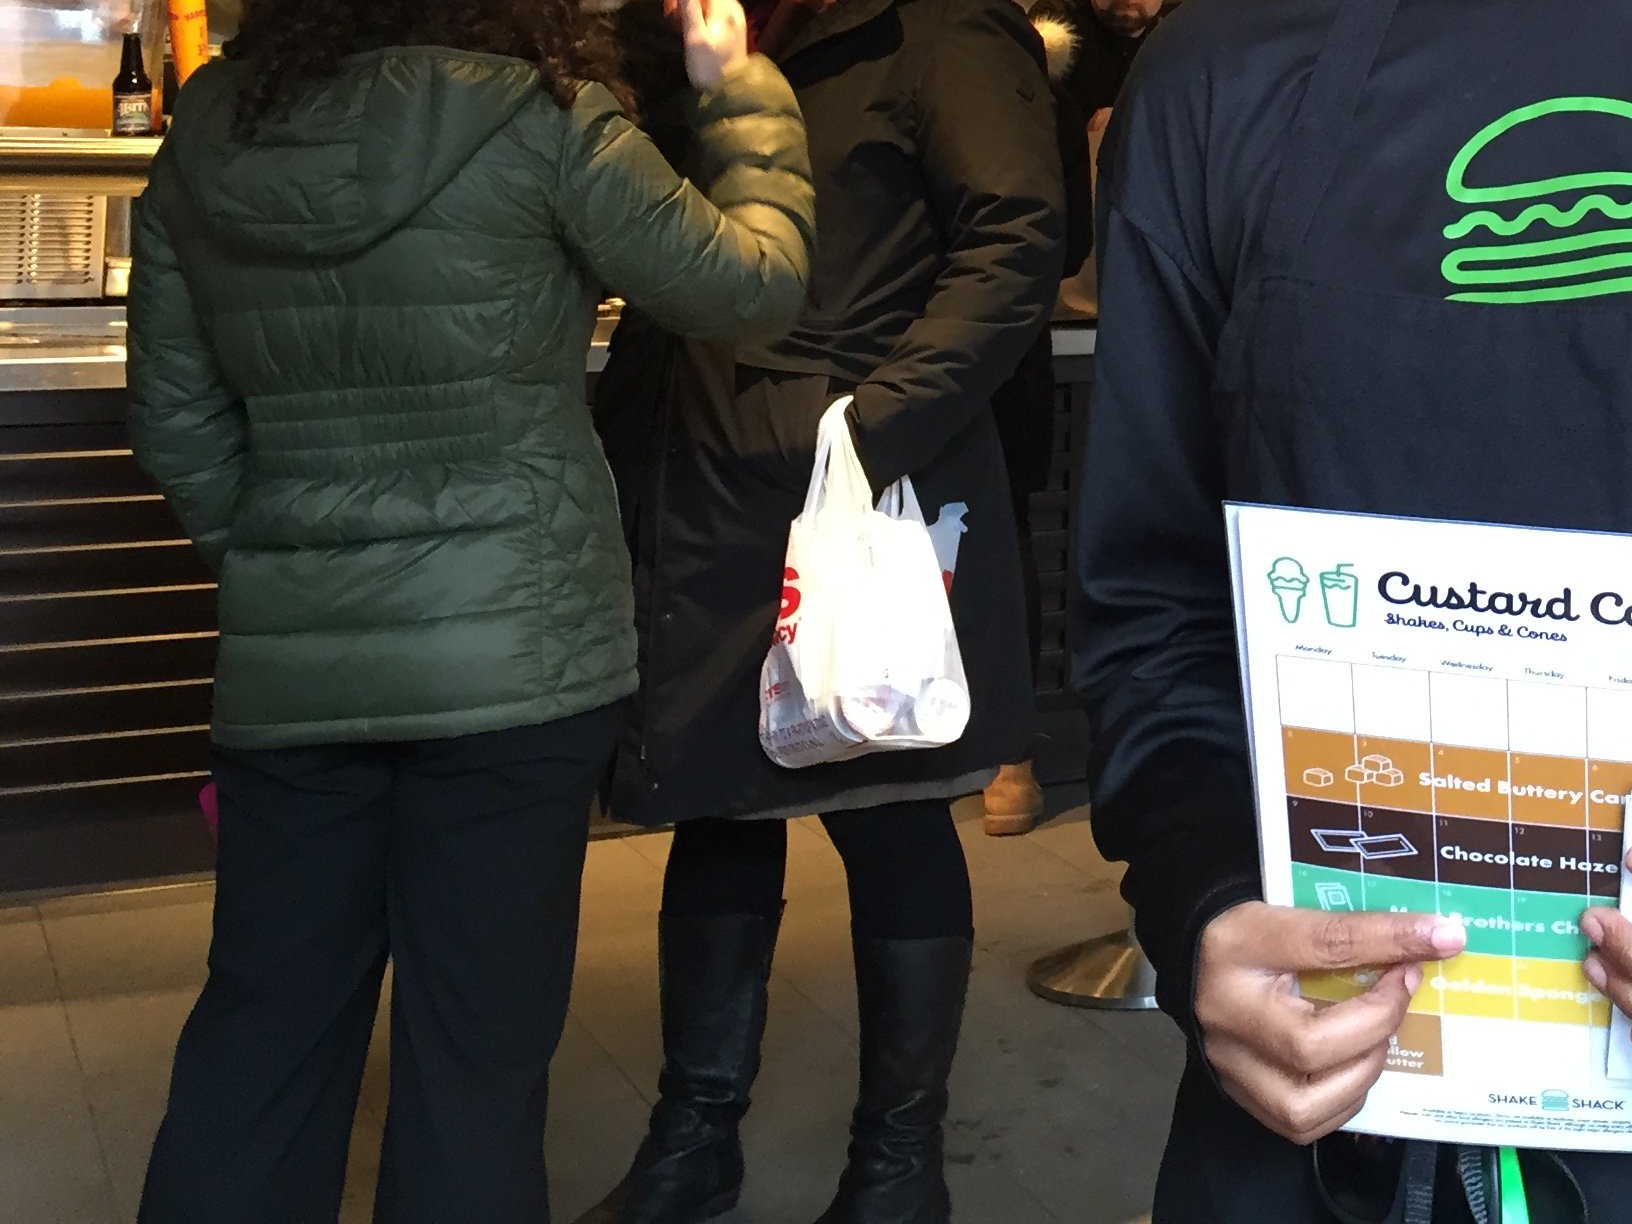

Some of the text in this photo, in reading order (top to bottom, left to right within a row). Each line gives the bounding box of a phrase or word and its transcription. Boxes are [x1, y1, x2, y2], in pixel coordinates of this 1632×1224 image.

[1377, 571, 1580, 621] Custard
[1384, 613, 1568, 645] Shakes, Cups & Cones
[1295, 644, 1333, 656] Monday
[1371, 651, 1407, 663] Tuesday
[1440, 659, 1494, 672] Wednesday
[1418, 772, 1491, 793] Salted
[1497, 780, 1584, 805] Buttery
[1514, 826, 1525, 836] 12
[1440, 846, 1553, 869] Chocolate
[1430, 976, 1512, 996] Golden
[1387, 1046, 1424, 1058] llow
[1386, 1057, 1424, 1069] utter
[1488, 1092, 1625, 1111] SHAKE SHACK
